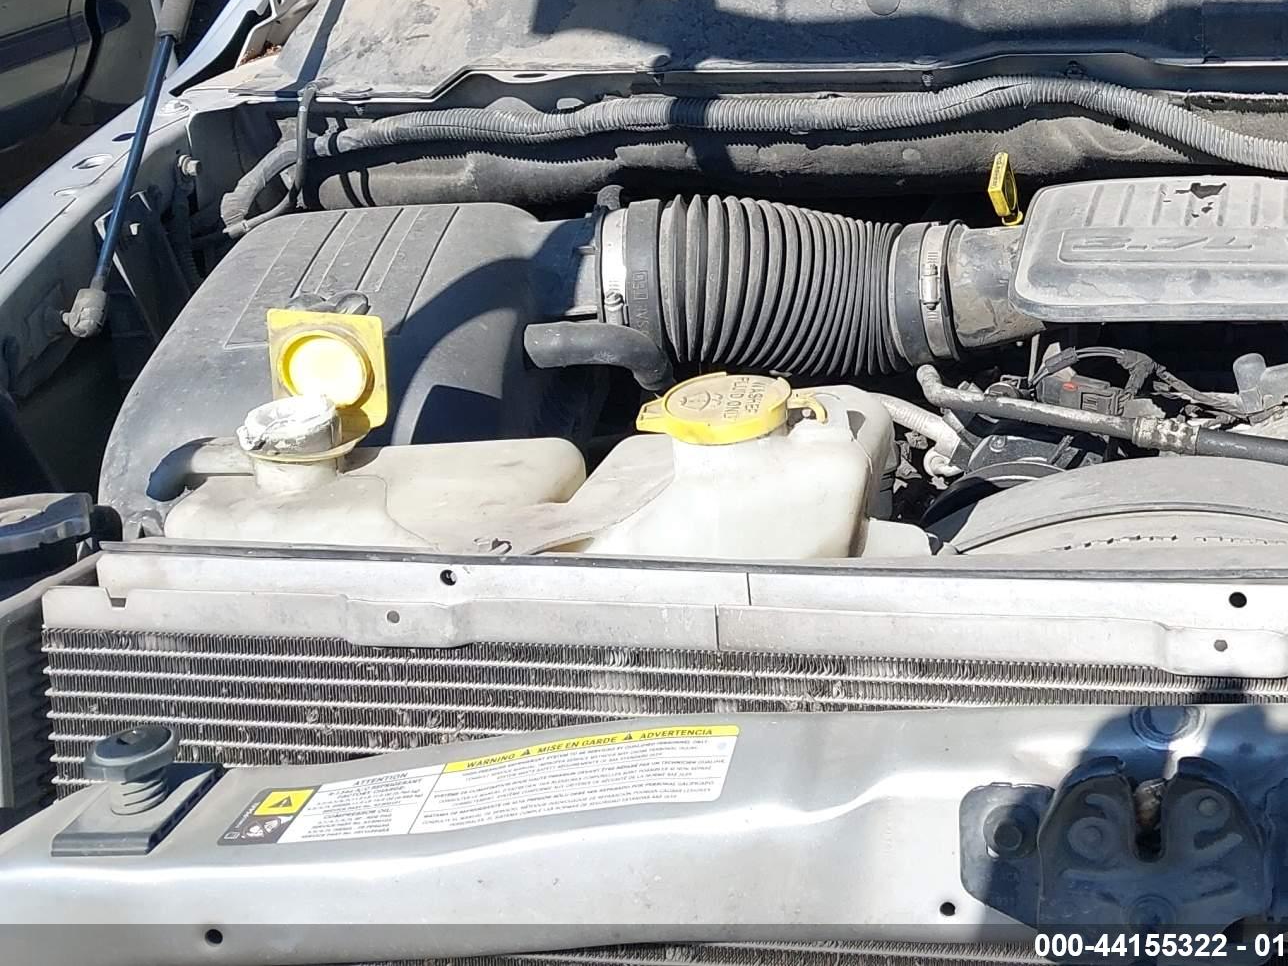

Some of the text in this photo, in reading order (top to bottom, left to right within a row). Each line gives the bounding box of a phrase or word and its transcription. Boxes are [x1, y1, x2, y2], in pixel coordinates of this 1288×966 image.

[466, 753, 515, 769] WARNING
[538, 743, 561, 754] MISE
[565, 741, 580, 750] EN
[582, 736, 617, 747] GARDE
[640, 729, 713, 740] ADVERTENCIA
[353, 772, 409, 785] ATTENTION
